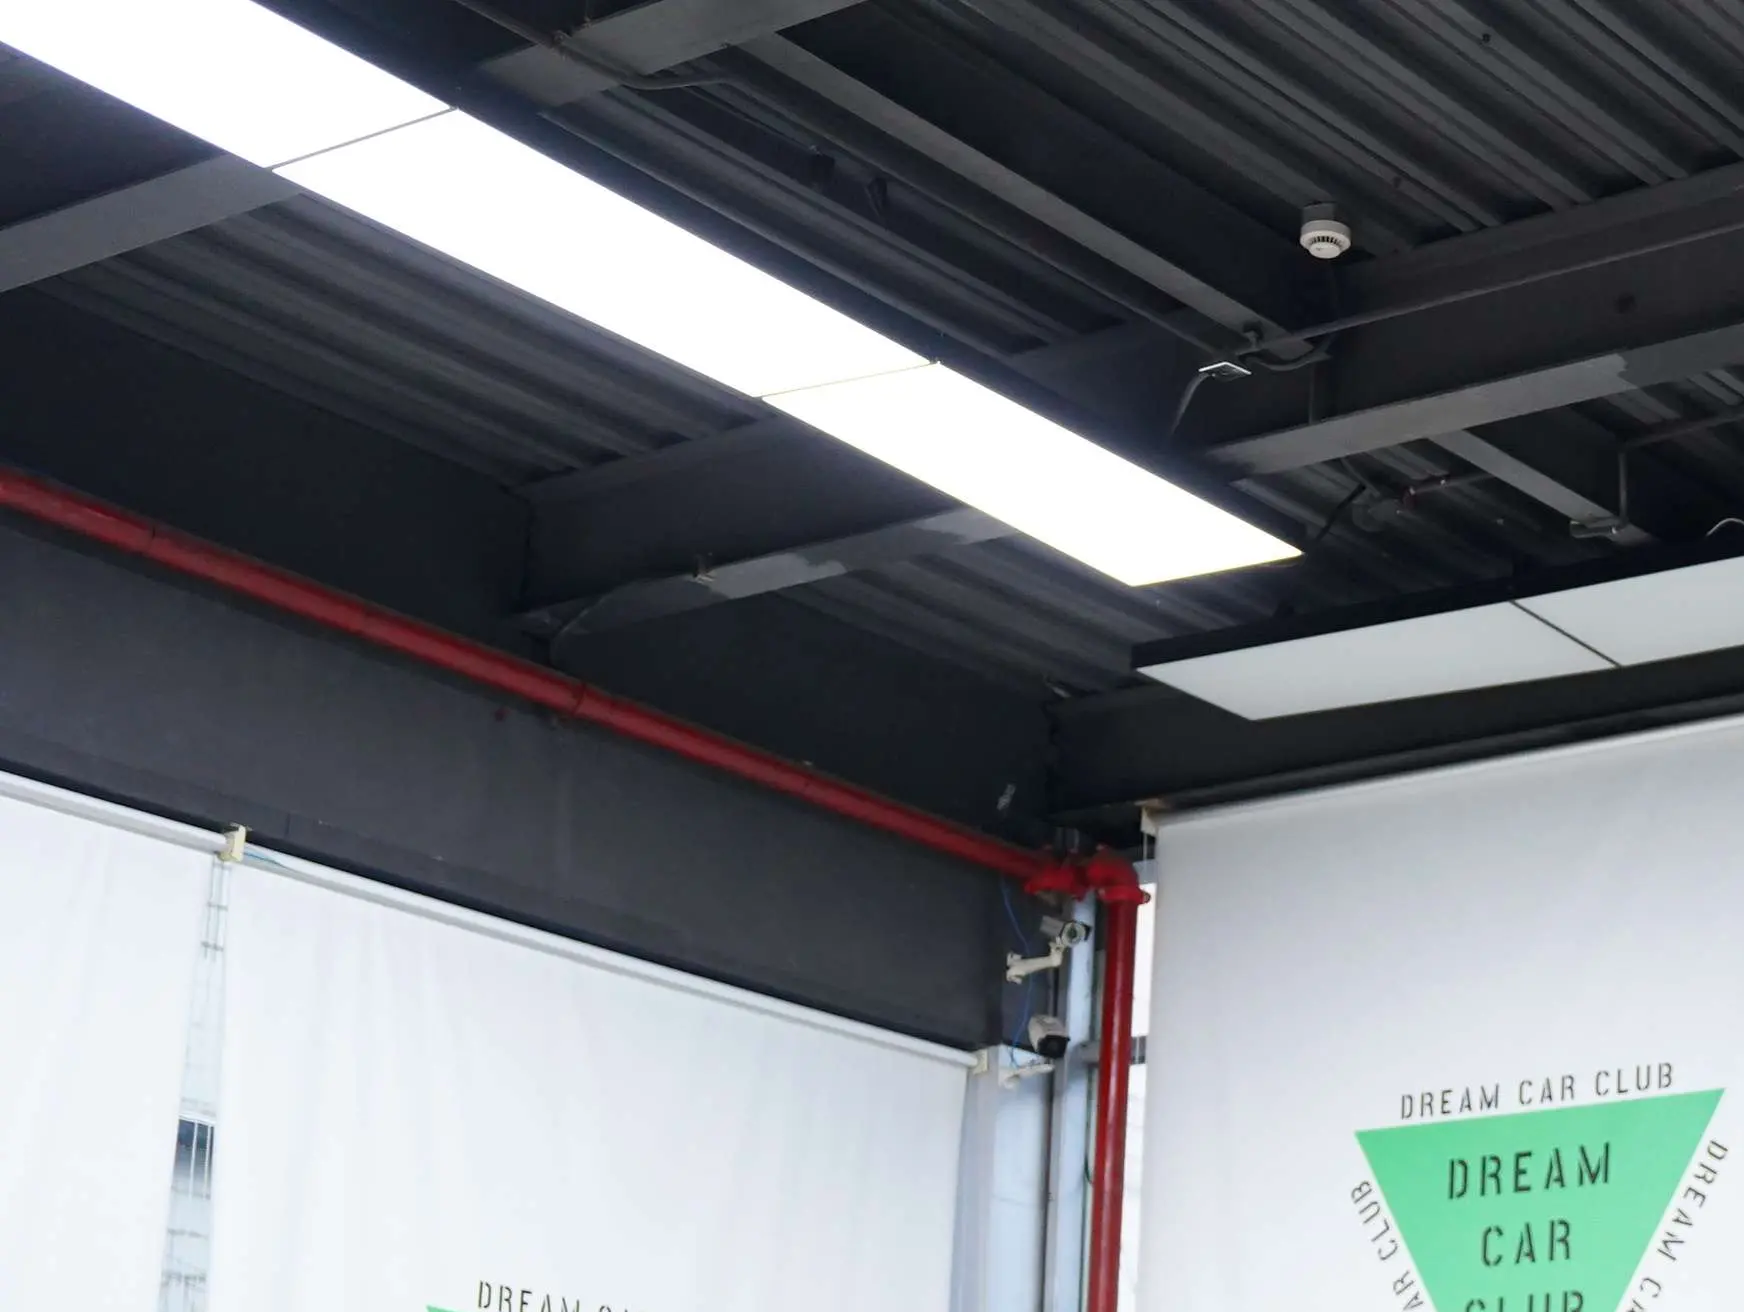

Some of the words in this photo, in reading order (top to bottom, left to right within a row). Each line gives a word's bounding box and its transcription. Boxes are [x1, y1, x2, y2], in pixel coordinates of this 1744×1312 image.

[1402, 1084, 1499, 1120] DREAM
[1519, 1075, 1574, 1105] CAR
[1595, 1063, 1672, 1096] CLUB
[1449, 1142, 1610, 1199] DREAM
[1351, 1181, 1398, 1260] CLUB
[1657, 1140, 1728, 1261] DREAM
[1482, 1219, 1570, 1266] CAR
